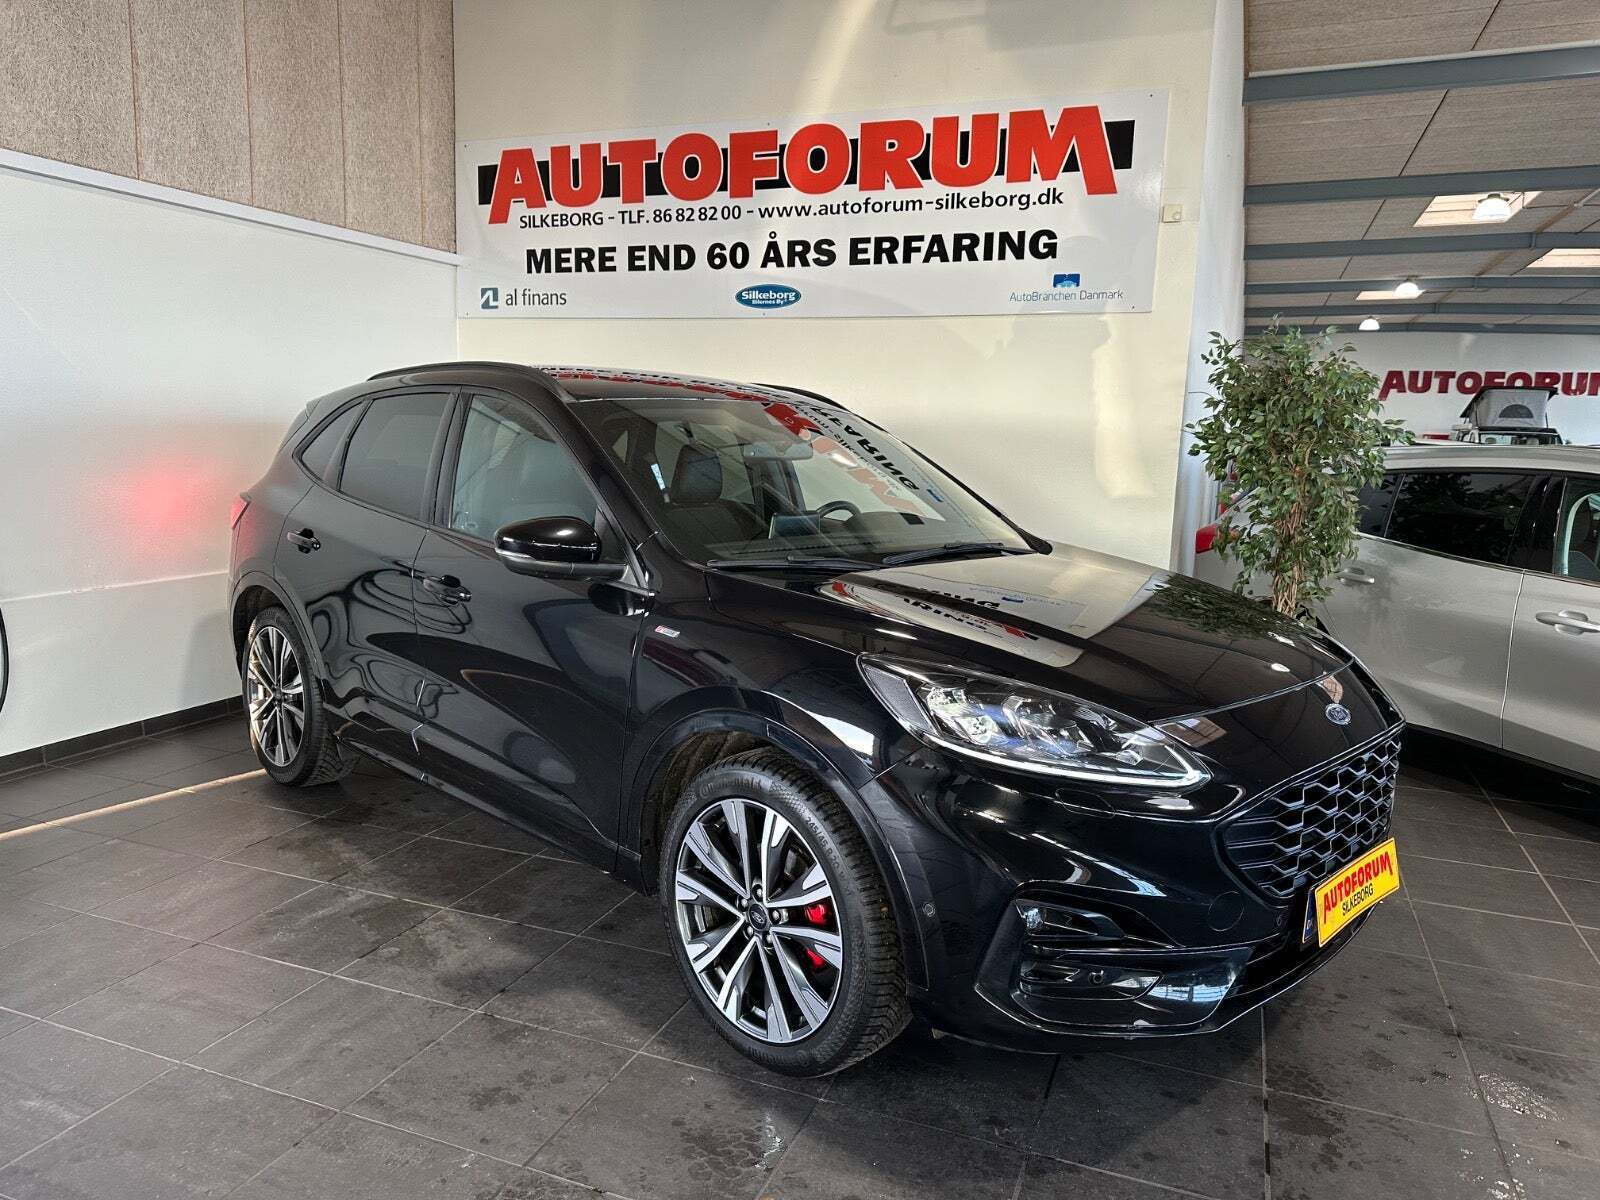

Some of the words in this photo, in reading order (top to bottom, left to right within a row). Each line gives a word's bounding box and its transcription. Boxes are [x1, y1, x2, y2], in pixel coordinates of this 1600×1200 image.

[488, 105, 1118, 224] AUTOFORUM
[519, 211, 604, 229] SILKEBORG
[618, 210, 650, 225] TLF.
[652, 208, 673, 223] 86
[675, 207, 696, 222] 82
[698, 206, 718, 221] 82
[720, 205, 742, 220] 00
[758, 187, 1064, 219] www.autoforum-silkeborg.dk
[526, 246, 617, 274] MERE
[627, 243, 697, 272] END
[706, 241, 750, 270] 60
[760, 231, 836, 269] ÅRS
[849, 229, 1058, 266] ERFARING
[505, 288, 518, 306] al
[521, 288, 567, 306] finans
[741, 290, 796, 301] Silkeborg
[1009, 291, 1077, 302] AutoBranchen
[1079, 290, 1124, 301] Danmark
[1323, 851, 1393, 925] AUTOFORUM
[1342, 883, 1374, 916] SILKEBORG
